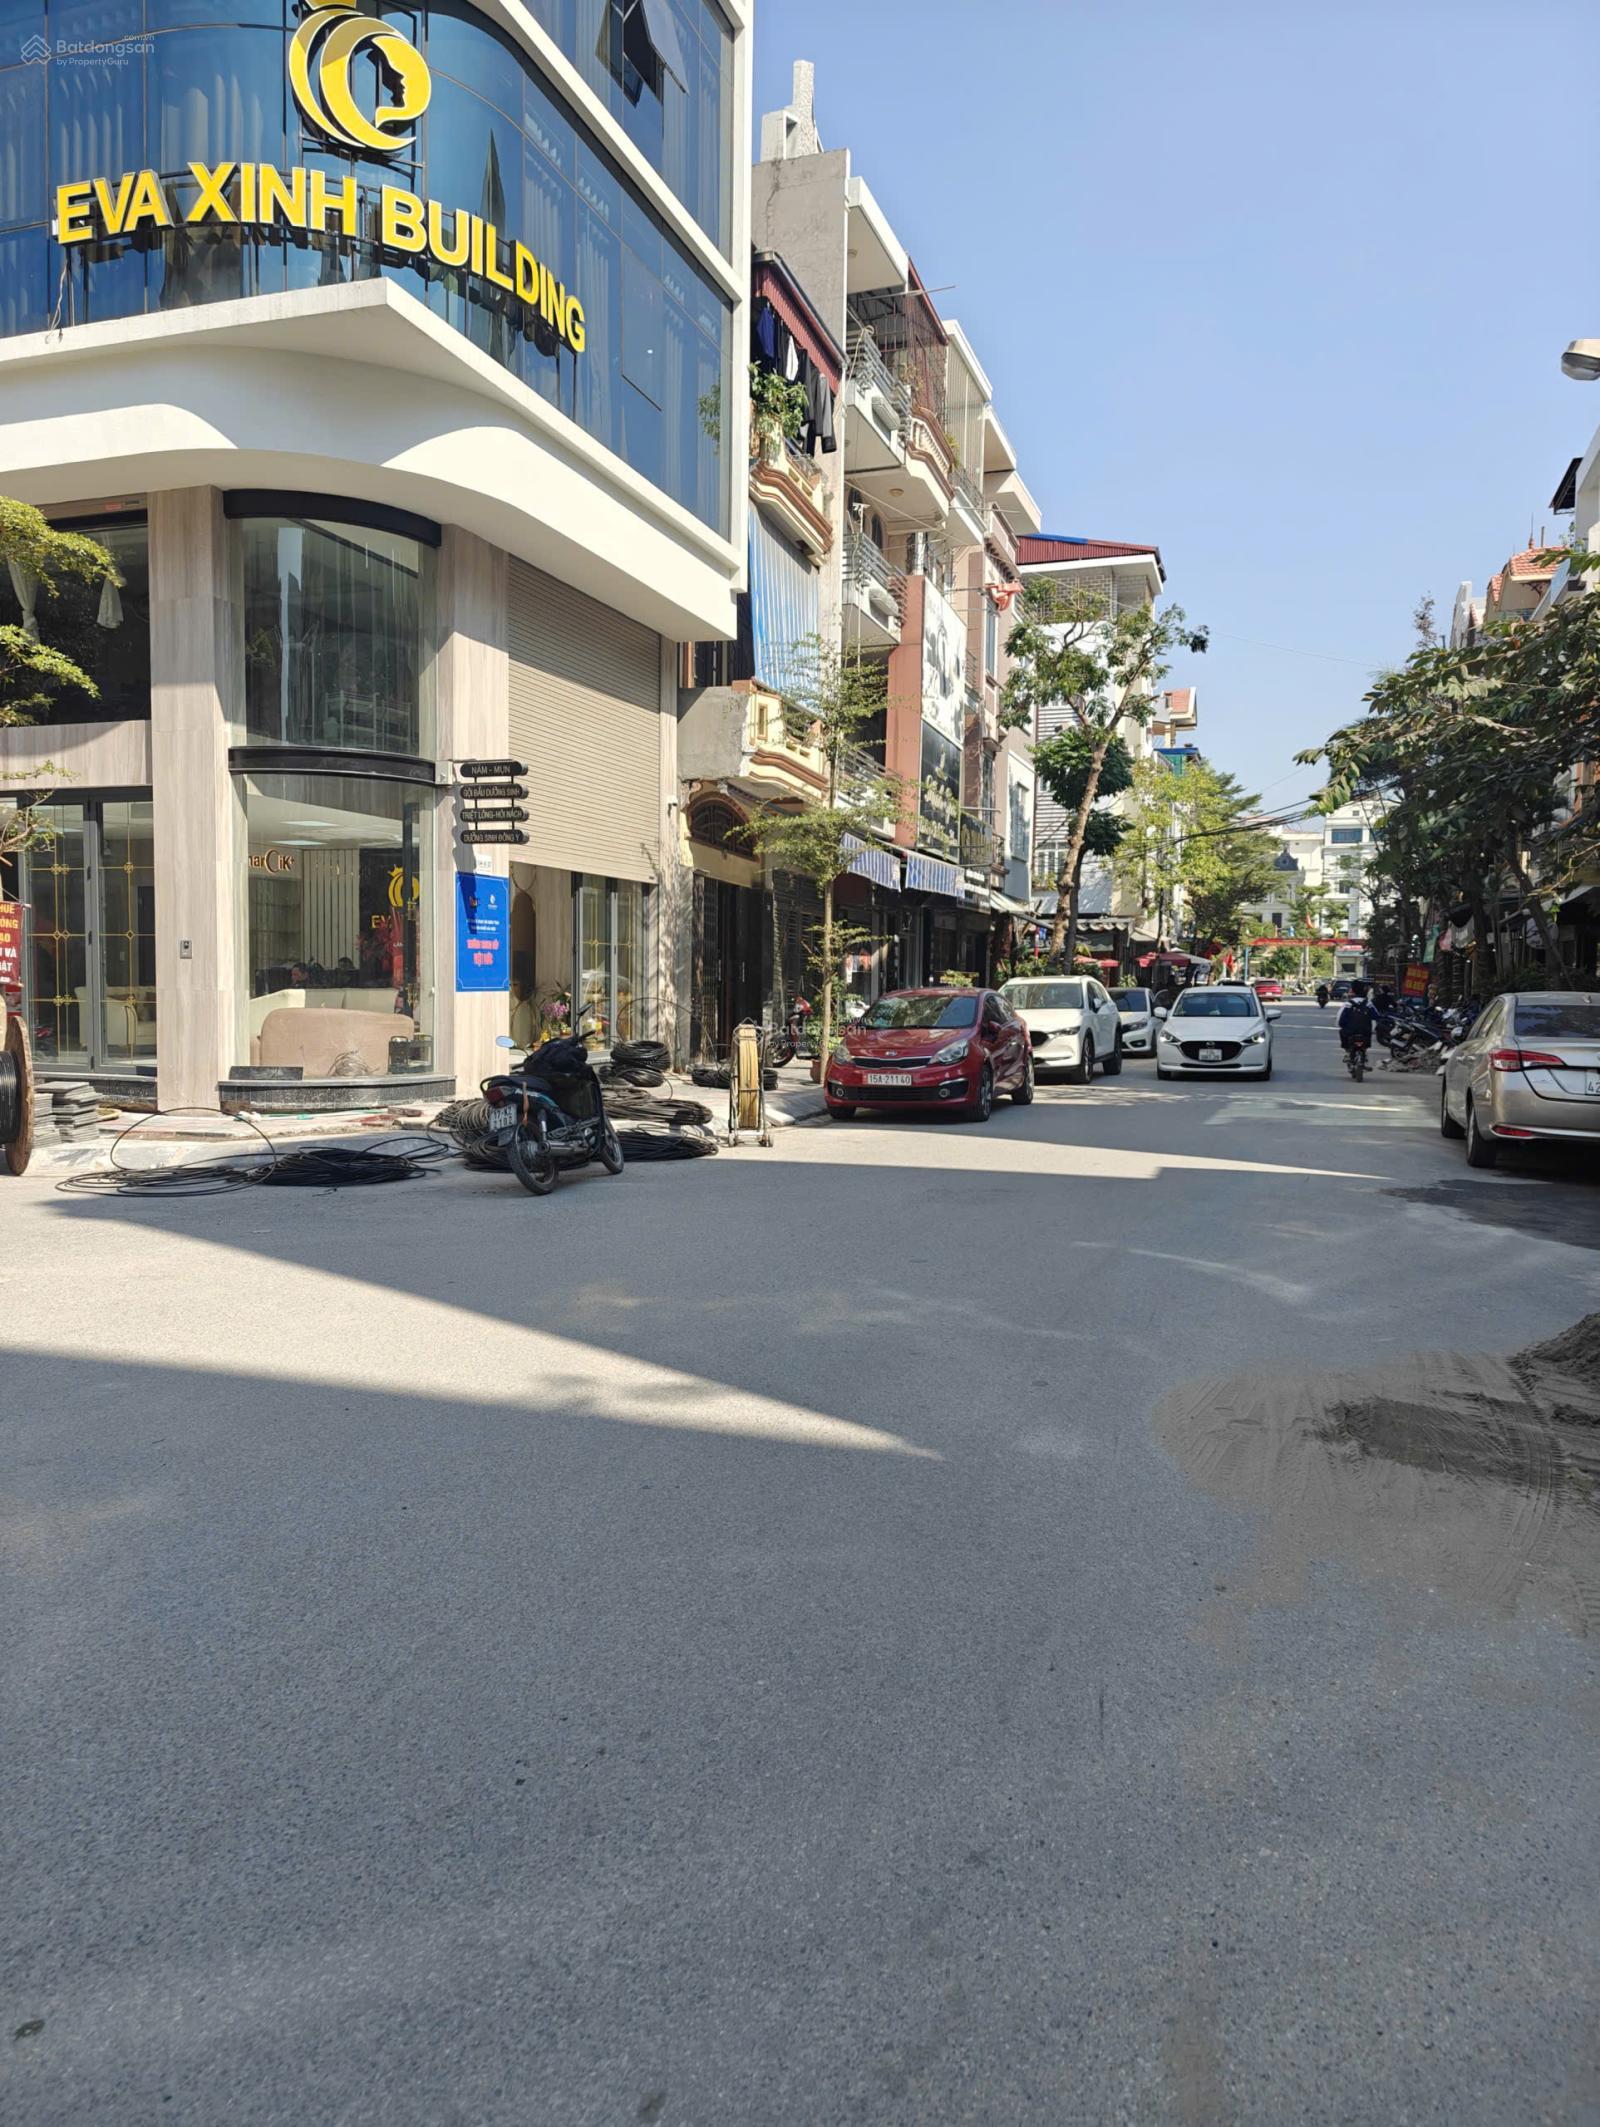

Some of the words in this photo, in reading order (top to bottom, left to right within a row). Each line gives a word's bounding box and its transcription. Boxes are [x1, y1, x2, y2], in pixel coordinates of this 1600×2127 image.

[56, 169, 172, 244] EVA
[186, 161, 357, 237] XINH
[382, 184, 586, 352] BUILDING
